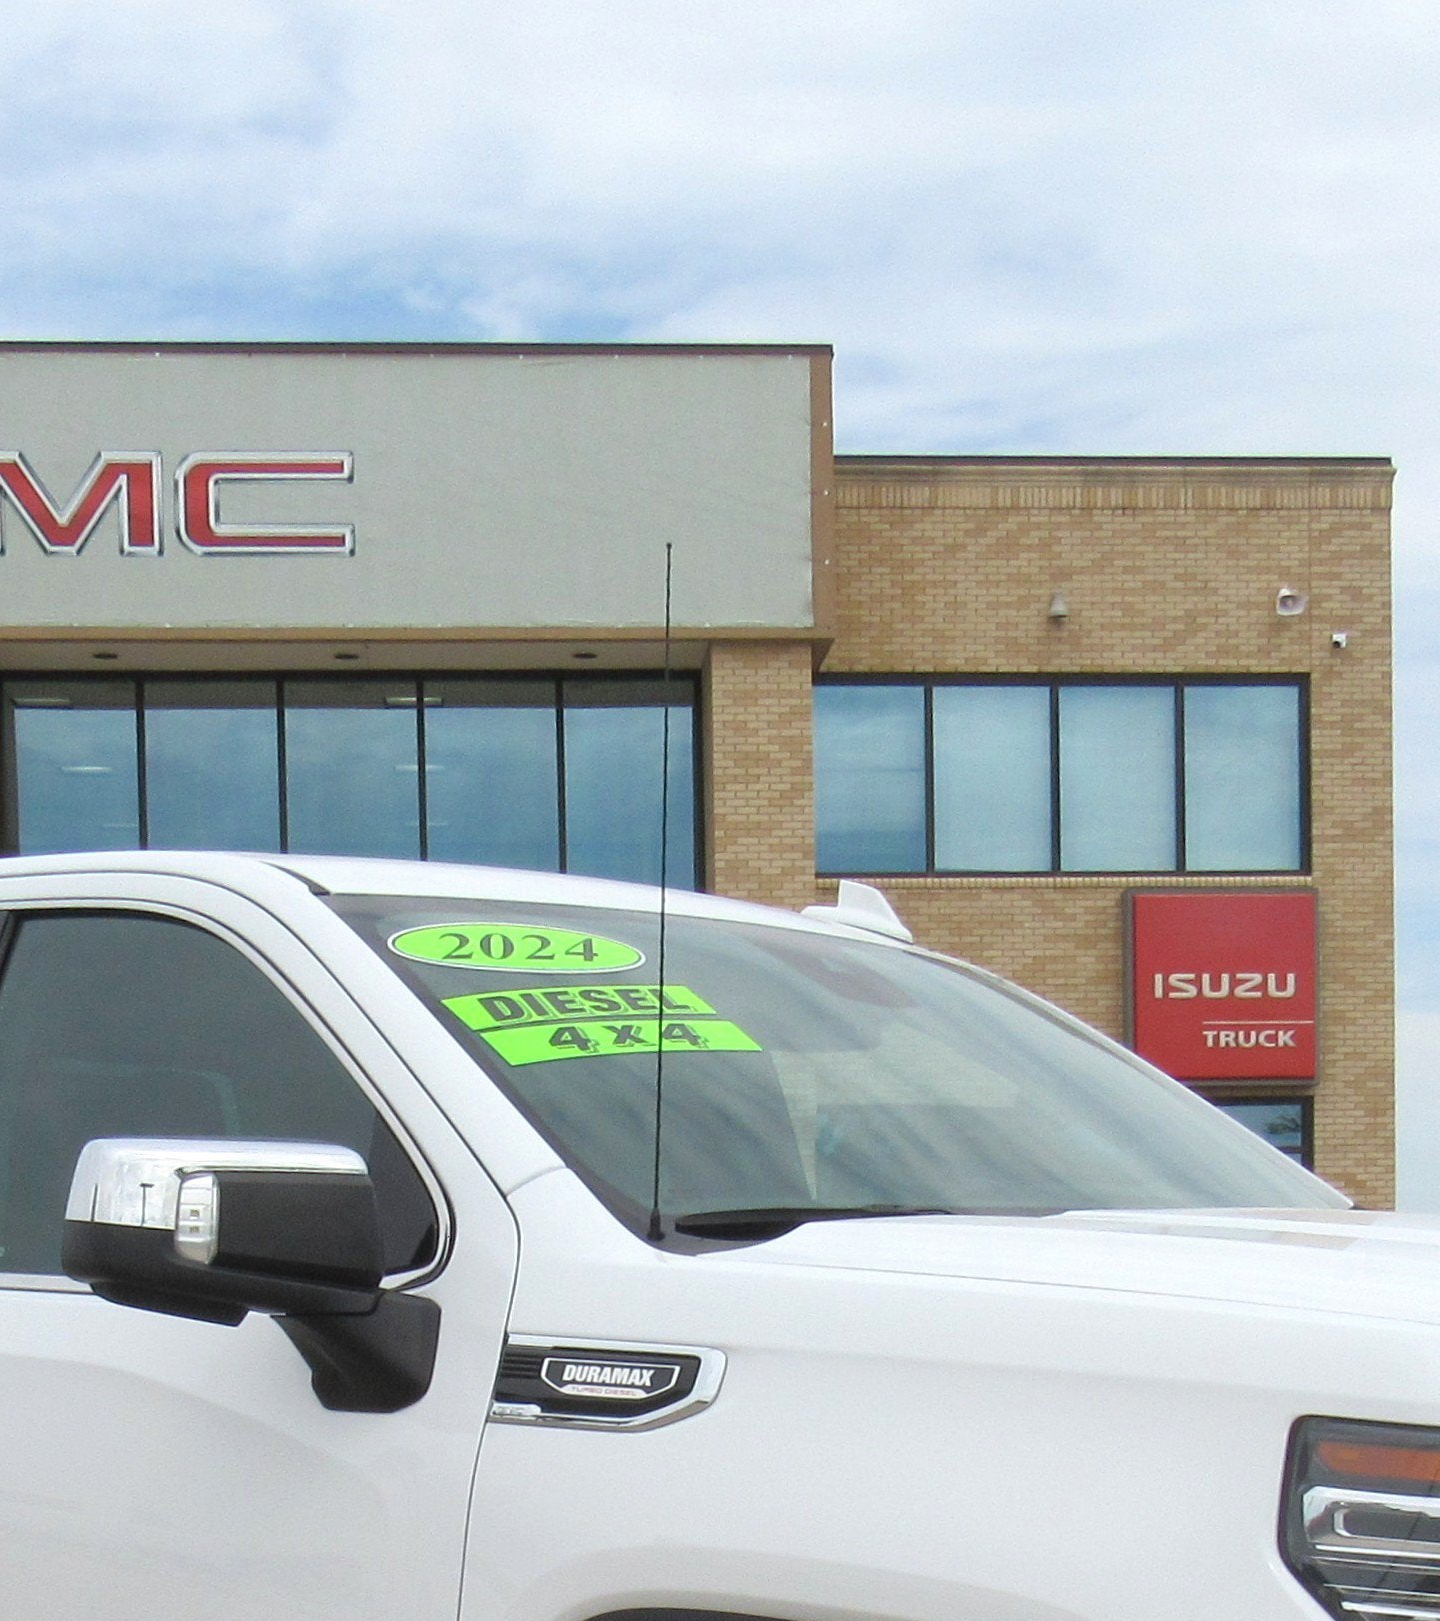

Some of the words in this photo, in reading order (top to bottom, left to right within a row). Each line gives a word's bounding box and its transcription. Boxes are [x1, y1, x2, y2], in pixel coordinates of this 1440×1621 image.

[438, 932, 599, 963] 2024
[1153, 972, 1297, 1000] ISUZU
[477, 987, 693, 1023] DIESEL
[1202, 1029, 1297, 1048] TRUCK
[562, 1364, 655, 1387] DURAMAX
